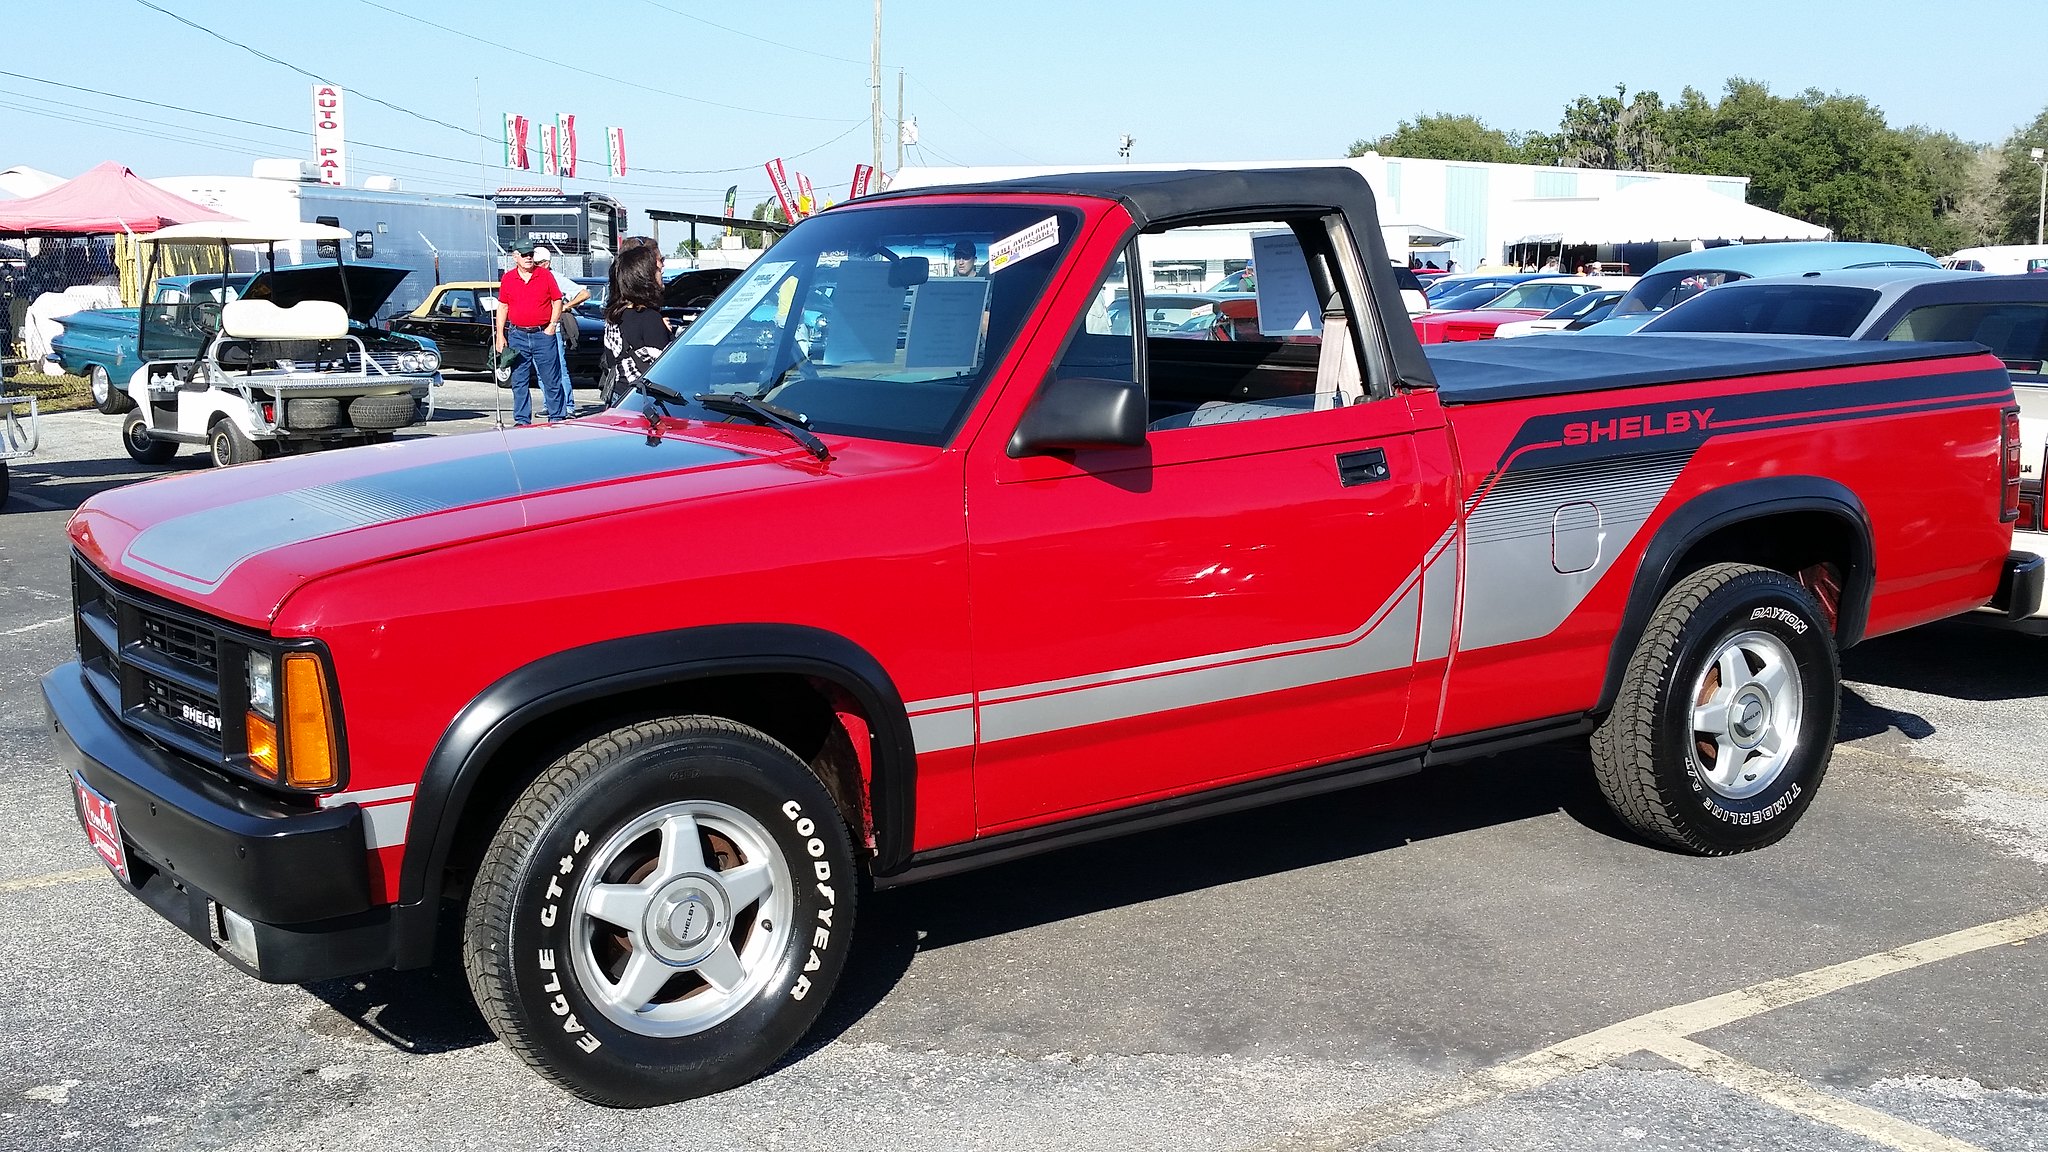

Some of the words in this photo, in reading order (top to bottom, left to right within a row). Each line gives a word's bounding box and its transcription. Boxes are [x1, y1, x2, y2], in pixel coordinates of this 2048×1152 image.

[318, 87, 338, 130] AUTO
[508, 119, 516, 165] PIZZA
[543, 130, 551, 173] PIZZA
[561, 119, 570, 165] PIZZA
[610, 133, 620, 175] PIZZA
[528, 231, 568, 240] RETIRED
[1563, 407, 1715, 446] SHELBY
[1750, 606, 1808, 635] DAYTON
[182, 704, 222, 732] SHELBY
[1703, 782, 1802, 826] TIMBERLINE
[540, 830, 591, 928] GT+4
[782, 799, 836, 1002] GOODYEAR
[681, 902, 696, 940] SHELBY
[538, 948, 602, 1055] EAGLE
